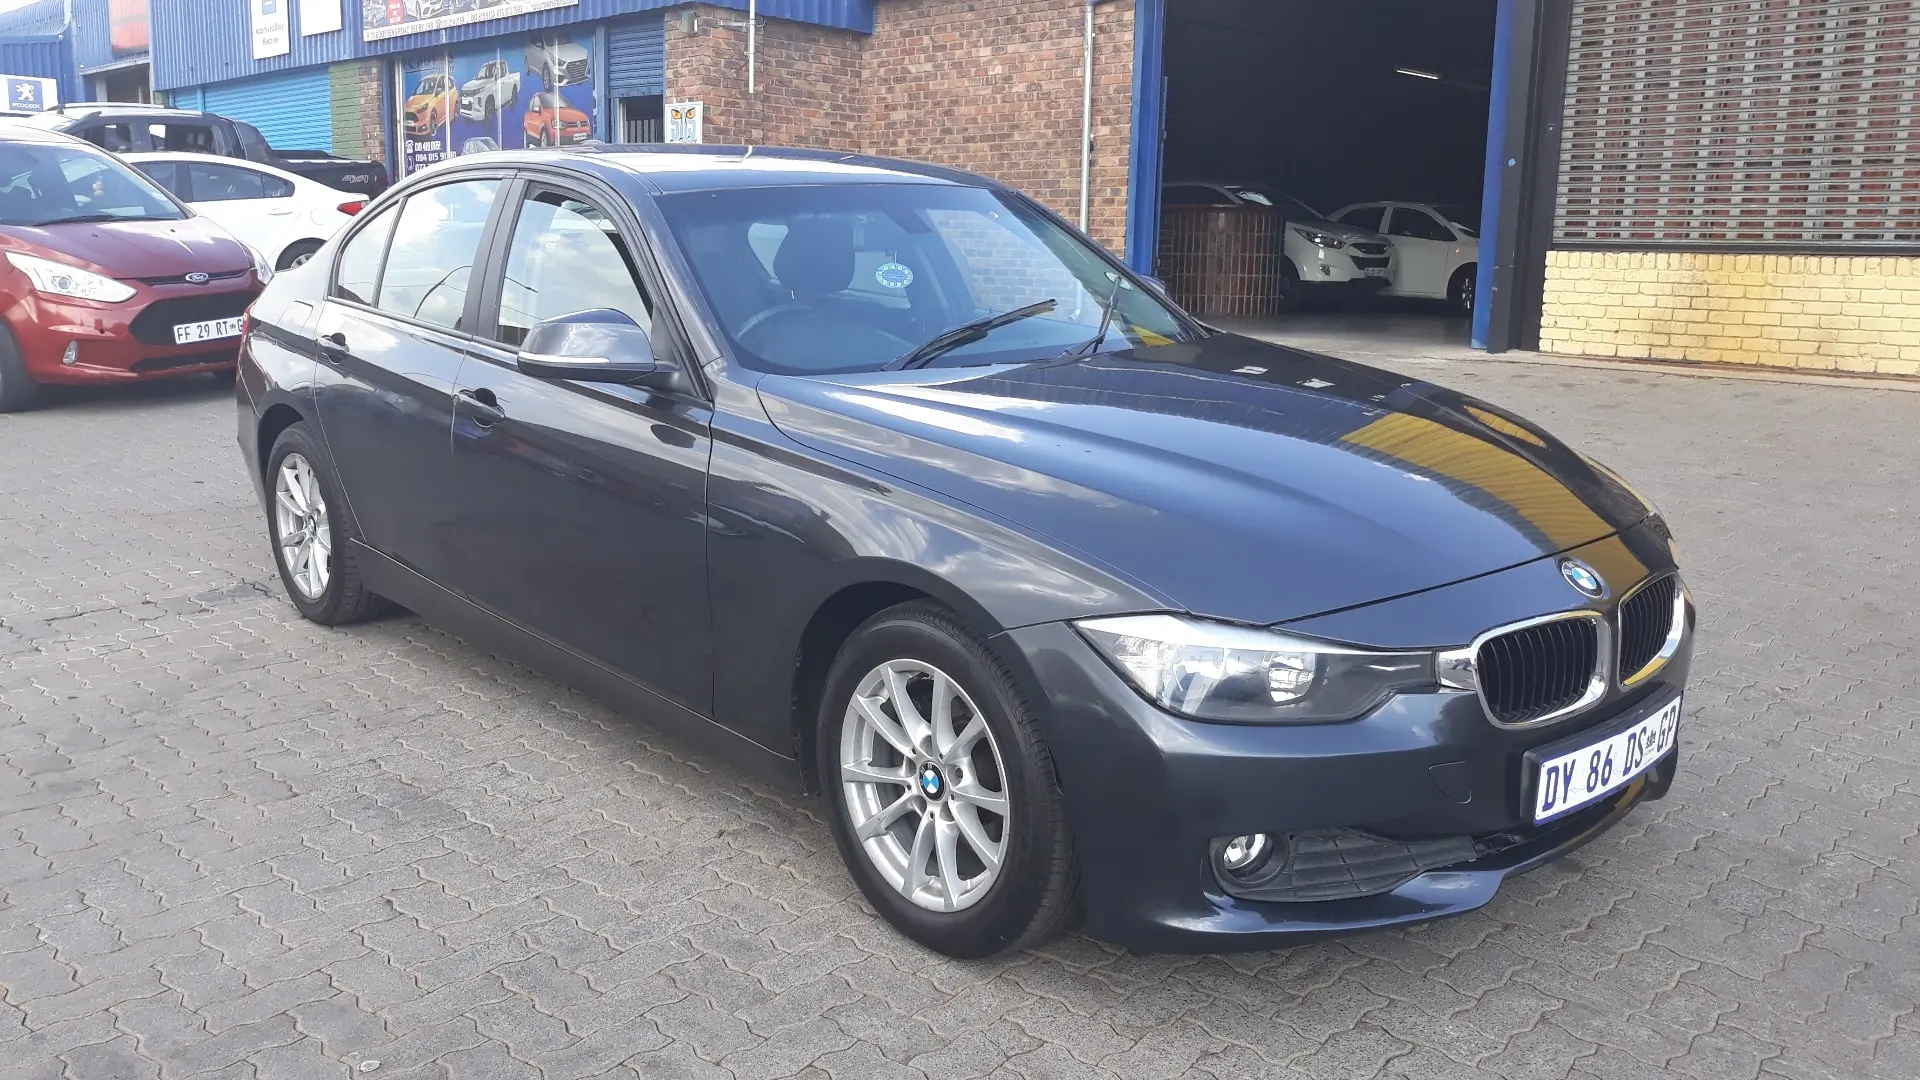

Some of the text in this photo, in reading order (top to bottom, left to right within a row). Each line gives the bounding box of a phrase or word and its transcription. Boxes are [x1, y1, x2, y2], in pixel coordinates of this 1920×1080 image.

[415, 153, 427, 162] 084
[428, 152, 439, 161] 815
[176, 318, 243, 342] FF 29 RT G
[1541, 704, 1677, 812] DY 86 DS GP
